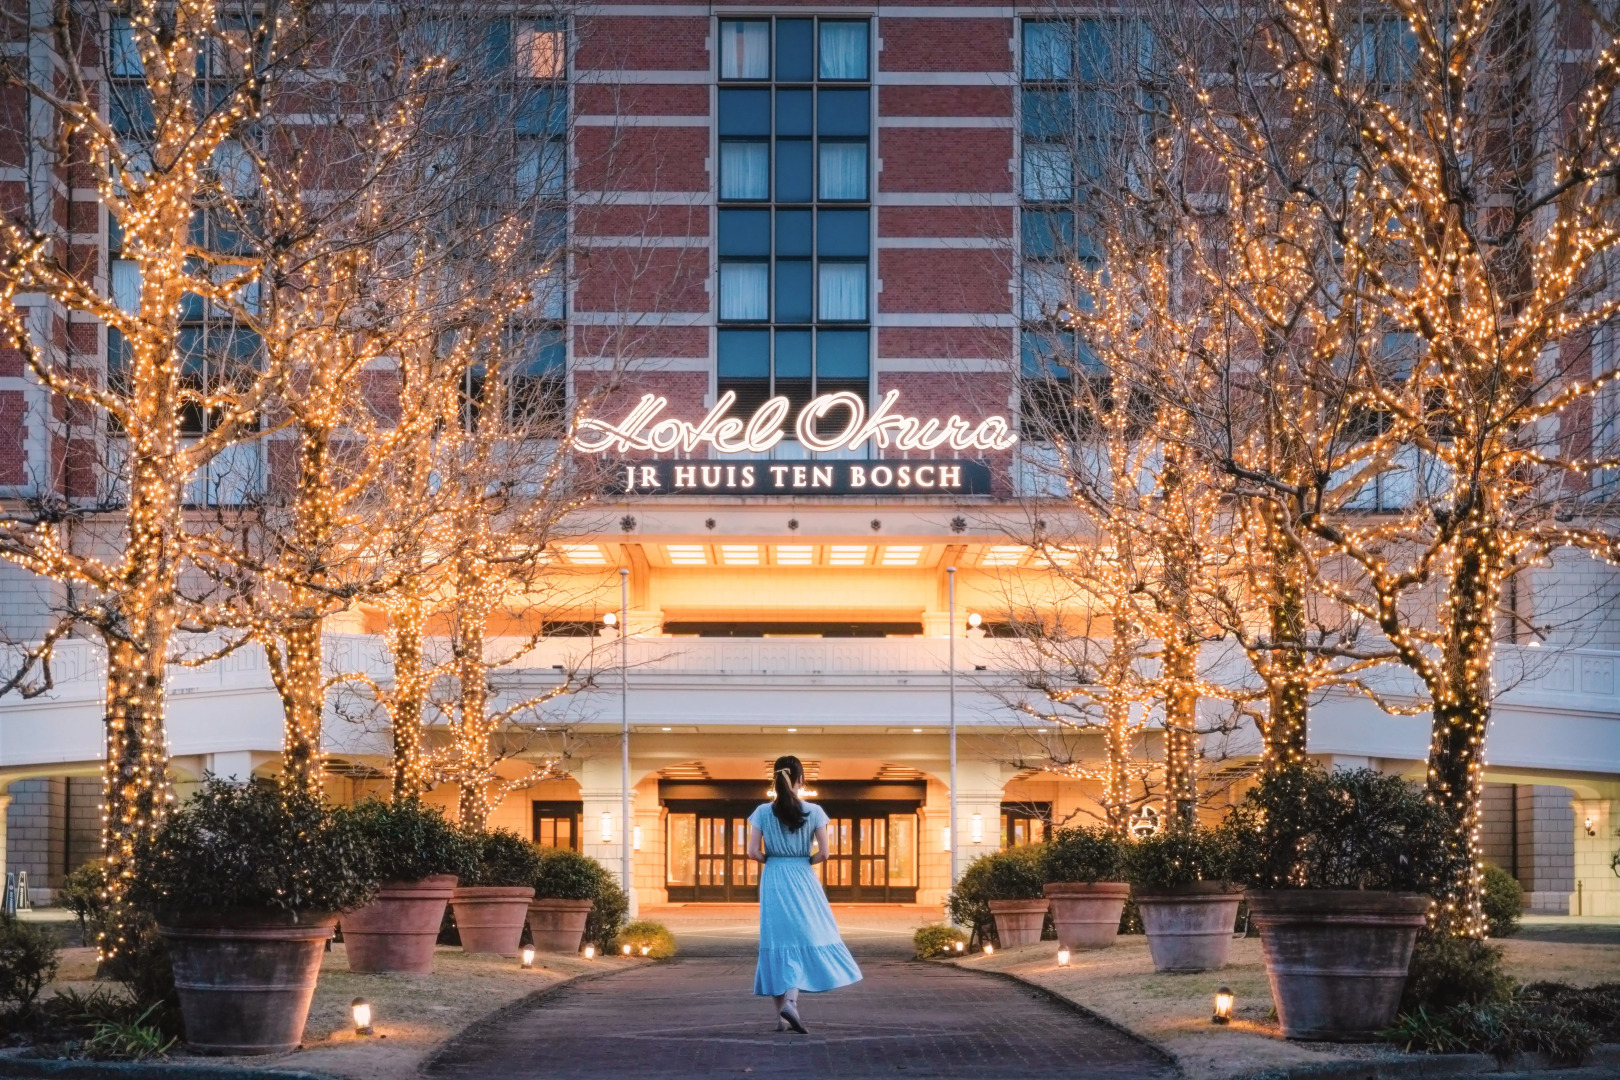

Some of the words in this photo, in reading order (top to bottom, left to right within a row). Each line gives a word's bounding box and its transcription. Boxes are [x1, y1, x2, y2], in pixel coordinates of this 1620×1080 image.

[568, 389, 790, 453] Hotel
[796, 388, 1018, 452] Okura
[625, 465, 662, 493] JR
[674, 465, 756, 488] HUIS
[769, 465, 834, 488] TEN
[850, 465, 962, 488] BOSCH
